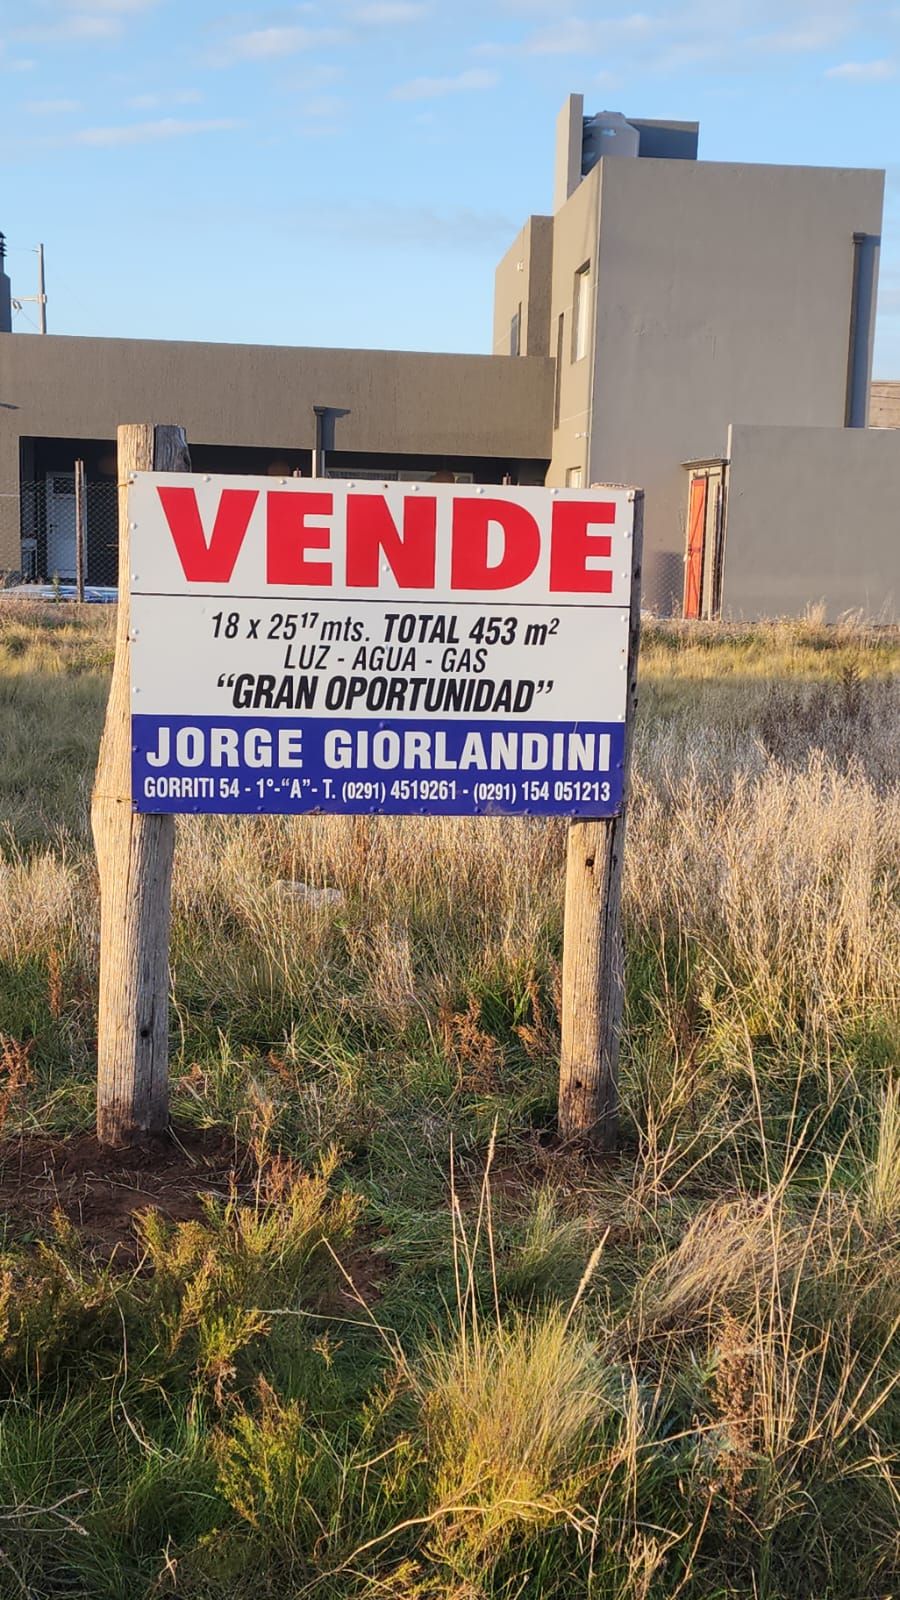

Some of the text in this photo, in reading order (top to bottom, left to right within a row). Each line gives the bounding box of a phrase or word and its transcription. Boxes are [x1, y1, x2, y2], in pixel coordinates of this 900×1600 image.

[157, 487, 616, 593] VENDE
[212, 612, 240, 638] 18
[247, 619, 260, 639] x
[320, 617, 370, 642] mts.
[384, 614, 460, 644] TOTAL
[469, 617, 518, 645] 453
[284, 645, 330, 669] LUZ
[352, 646, 416, 672] AGUA
[441, 648, 488, 673] GAS
[146, 726, 611, 771] JORGE GIORLANDINI
[144, 777, 215, 798] GORRITI
[220, 778, 239, 797] 54
[323, 779, 336, 799] T.
[342, 782, 386, 802] (0291)
[391, 780, 456, 800] 4519261
[473, 783, 516, 803] (0291)
[521, 781, 549, 800] 154
[554, 782, 610, 801] 051213
